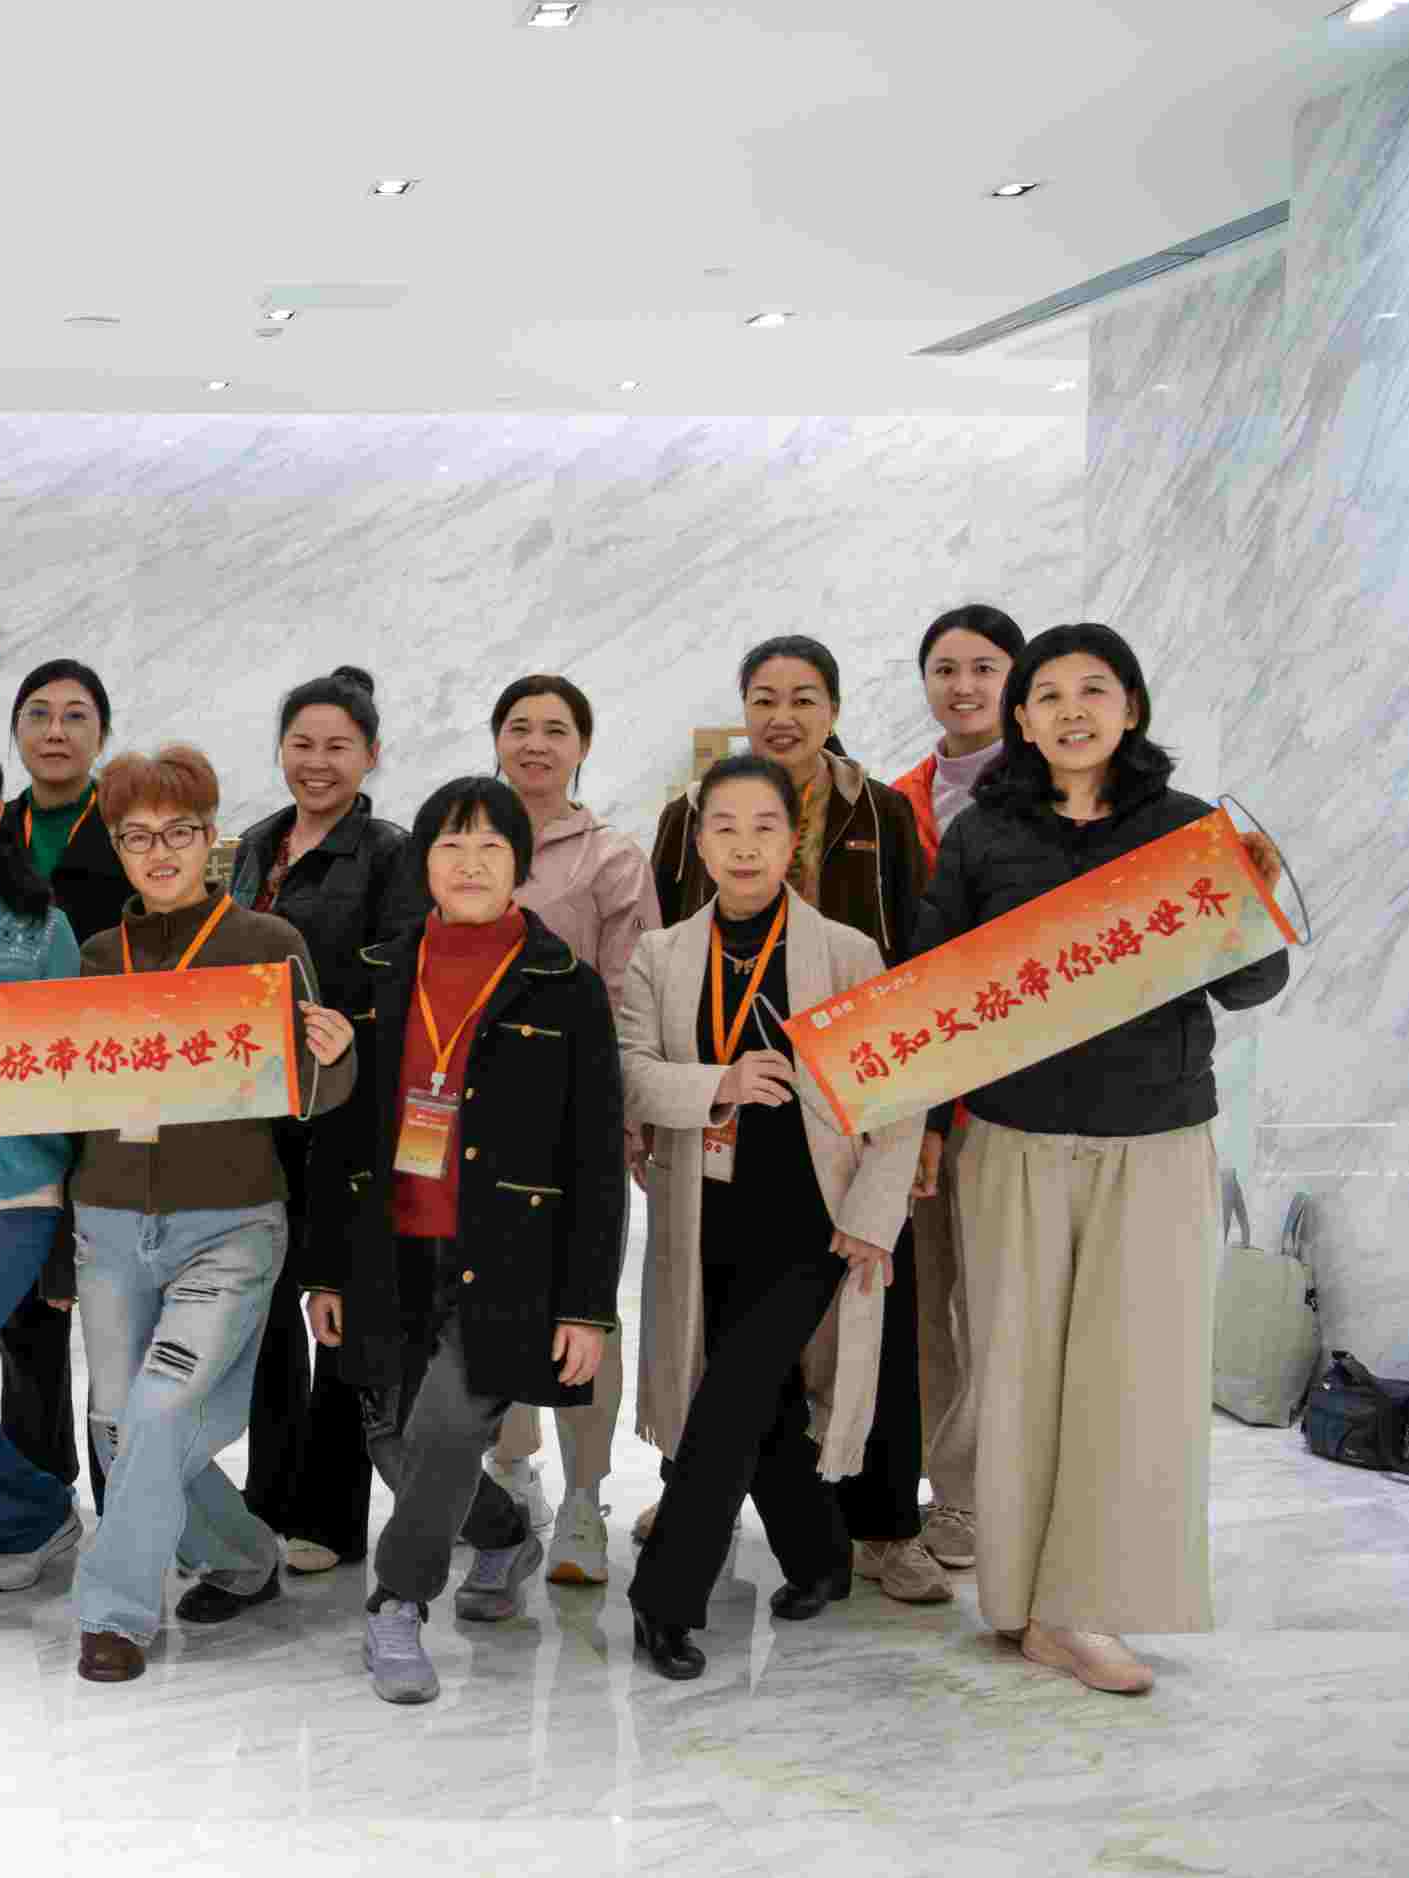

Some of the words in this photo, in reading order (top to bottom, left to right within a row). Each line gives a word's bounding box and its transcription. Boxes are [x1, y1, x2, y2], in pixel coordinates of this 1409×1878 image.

[848, 877, 1230, 1083] 简知文旅带你游世界
